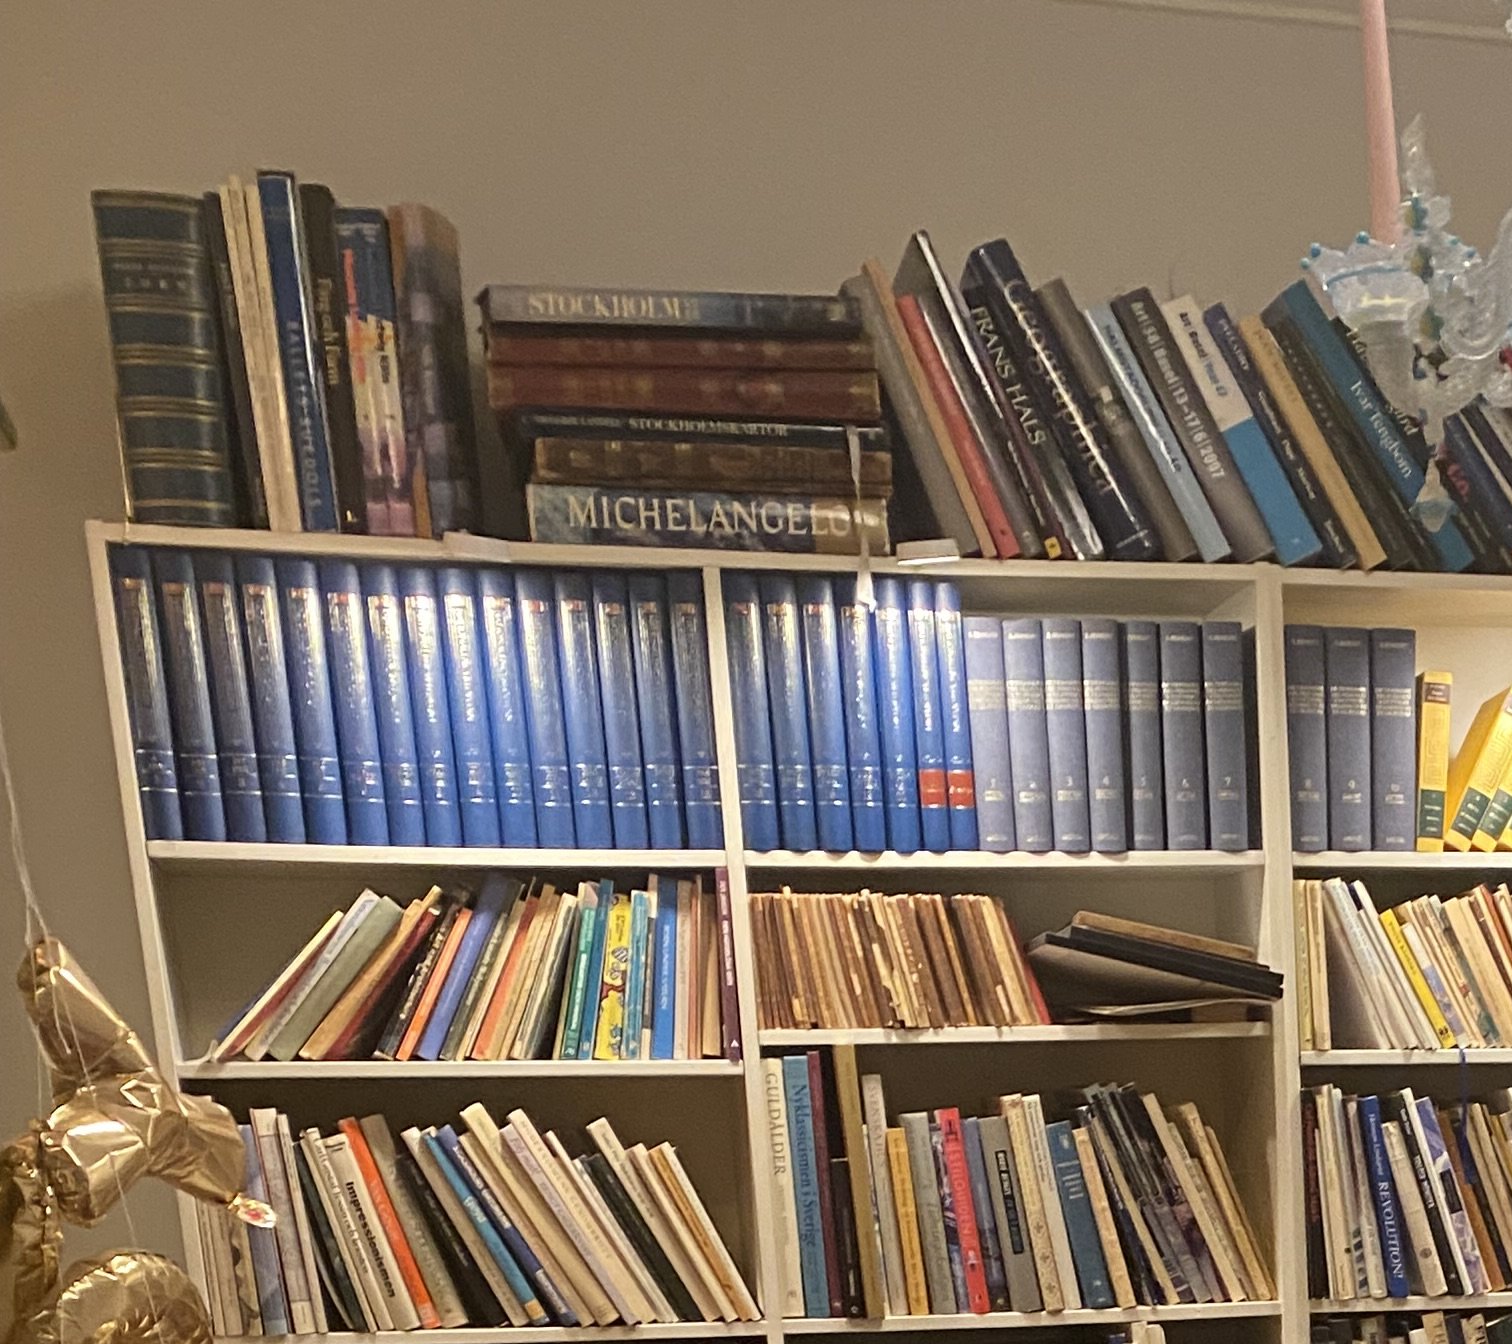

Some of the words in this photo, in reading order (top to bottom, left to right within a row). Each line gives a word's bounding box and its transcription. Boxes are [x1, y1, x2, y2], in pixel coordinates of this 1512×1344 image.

[527, 294, 682, 320] STOCKHOLM
[971, 306, 1016, 378] FRANS
[1006, 383, 1047, 446] HALS
[567, 494, 851, 537] MICHELANGELO
[764, 1072, 787, 1177] GULDÅLDER
[793, 1082, 811, 1188] Nyklassicismen
[344, 1179, 397, 1299] Impressionismen
[799, 1197, 818, 1247] Sverige
[1377, 1181, 1404, 1280] REVOLUTION!
